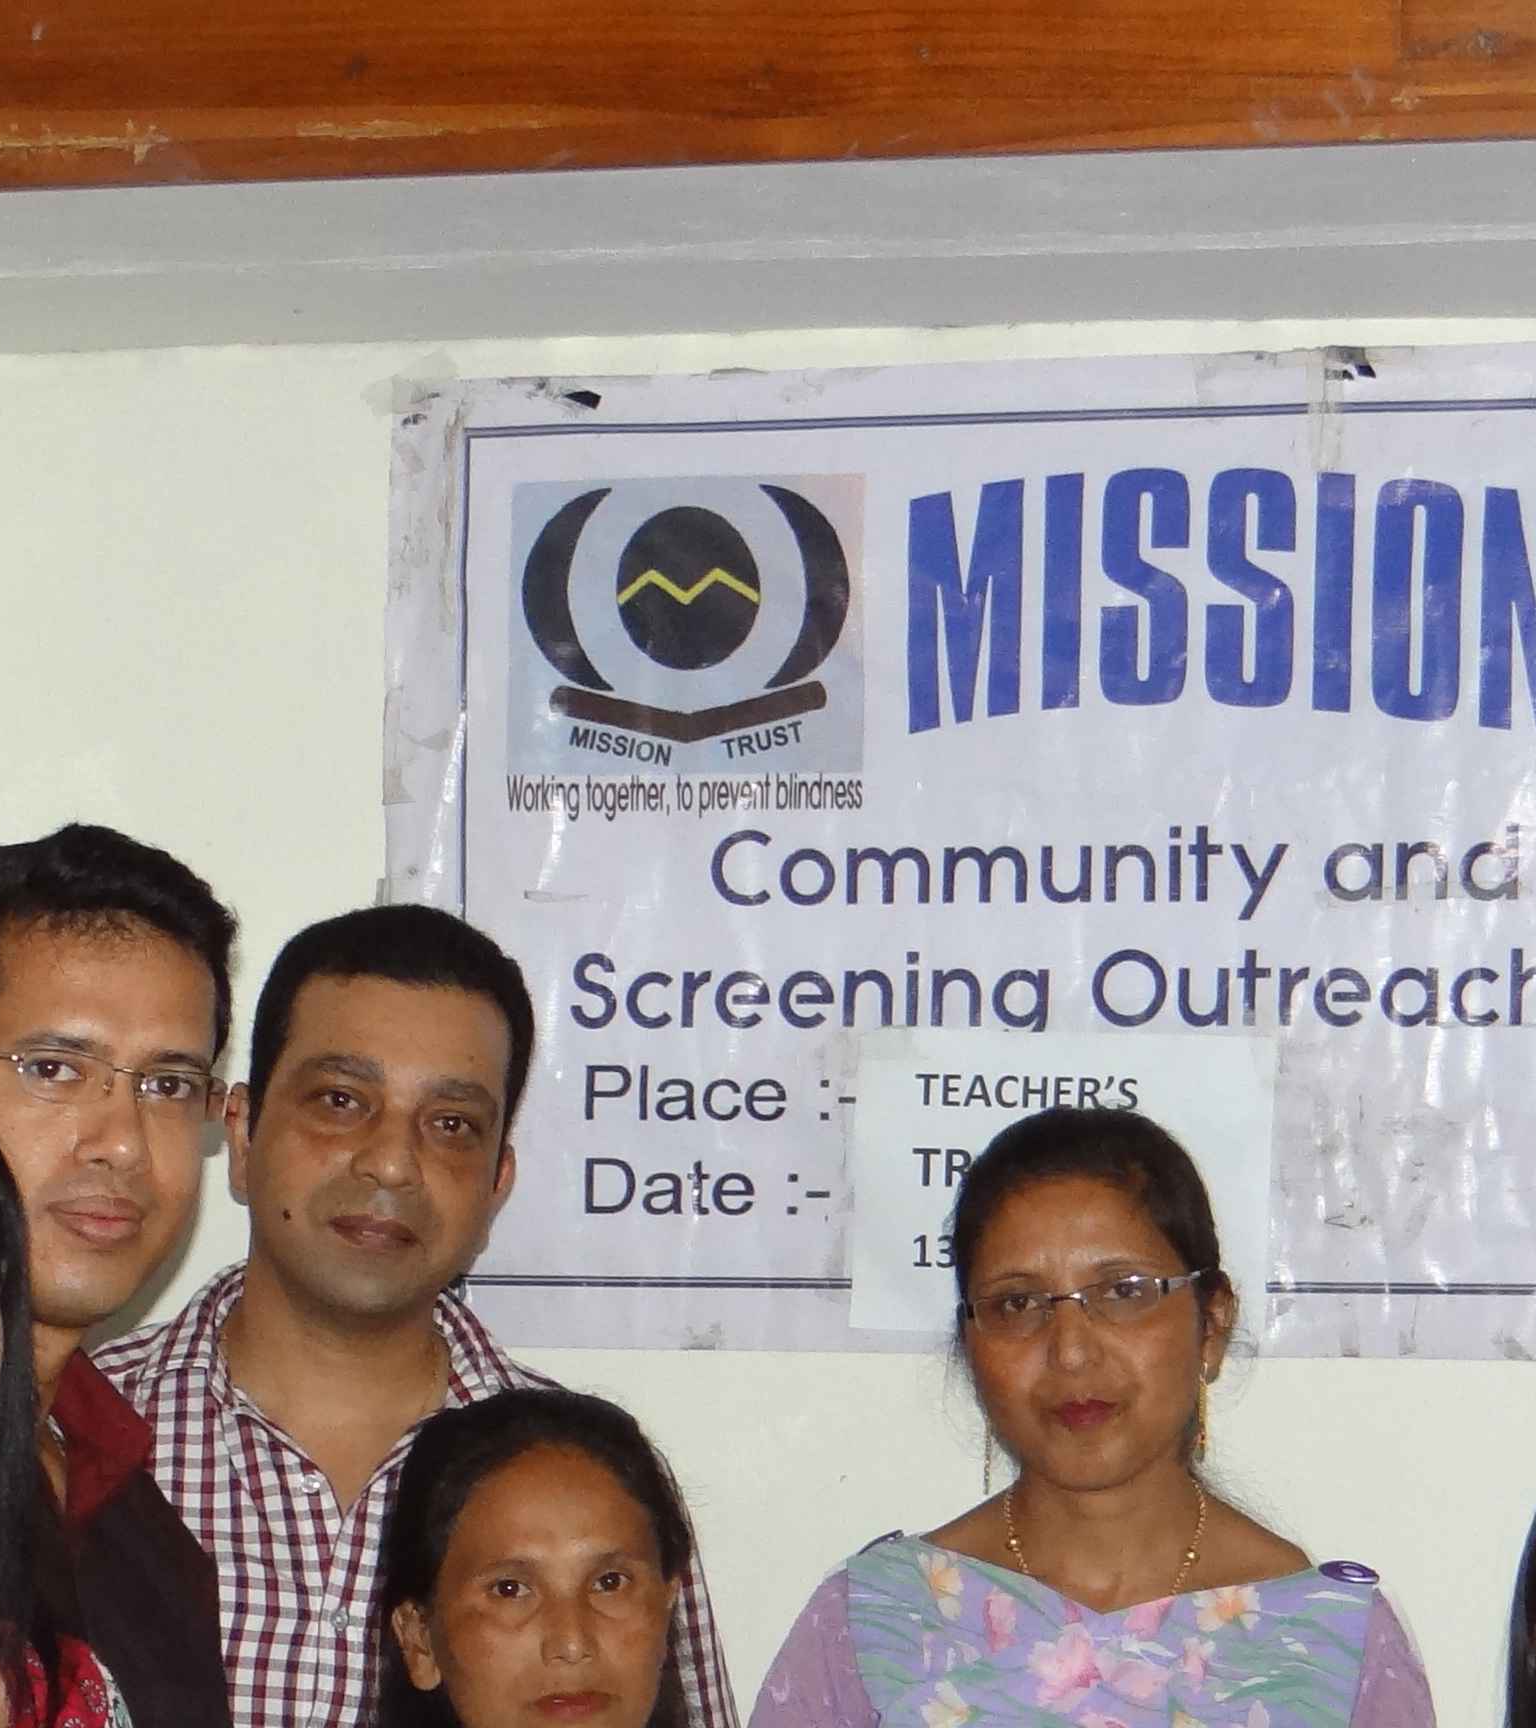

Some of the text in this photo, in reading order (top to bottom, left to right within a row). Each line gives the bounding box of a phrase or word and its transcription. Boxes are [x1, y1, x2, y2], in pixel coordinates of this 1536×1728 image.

[568, 720, 804, 767] MISSION TRUST
[506, 772, 863, 822] Working together, to prevent blindness
[710, 825, 1288, 920] Community
[1324, 822, 1521, 903] and
[571, 951, 1050, 1033] Screening
[584, 1063, 788, 1122] Place
[915, 1073, 1139, 1111] TEACHER'S
[584, 1157, 756, 1217] Date
[912, 1147, 973, 1188] TR
[912, 1234, 957, 1268] 13
